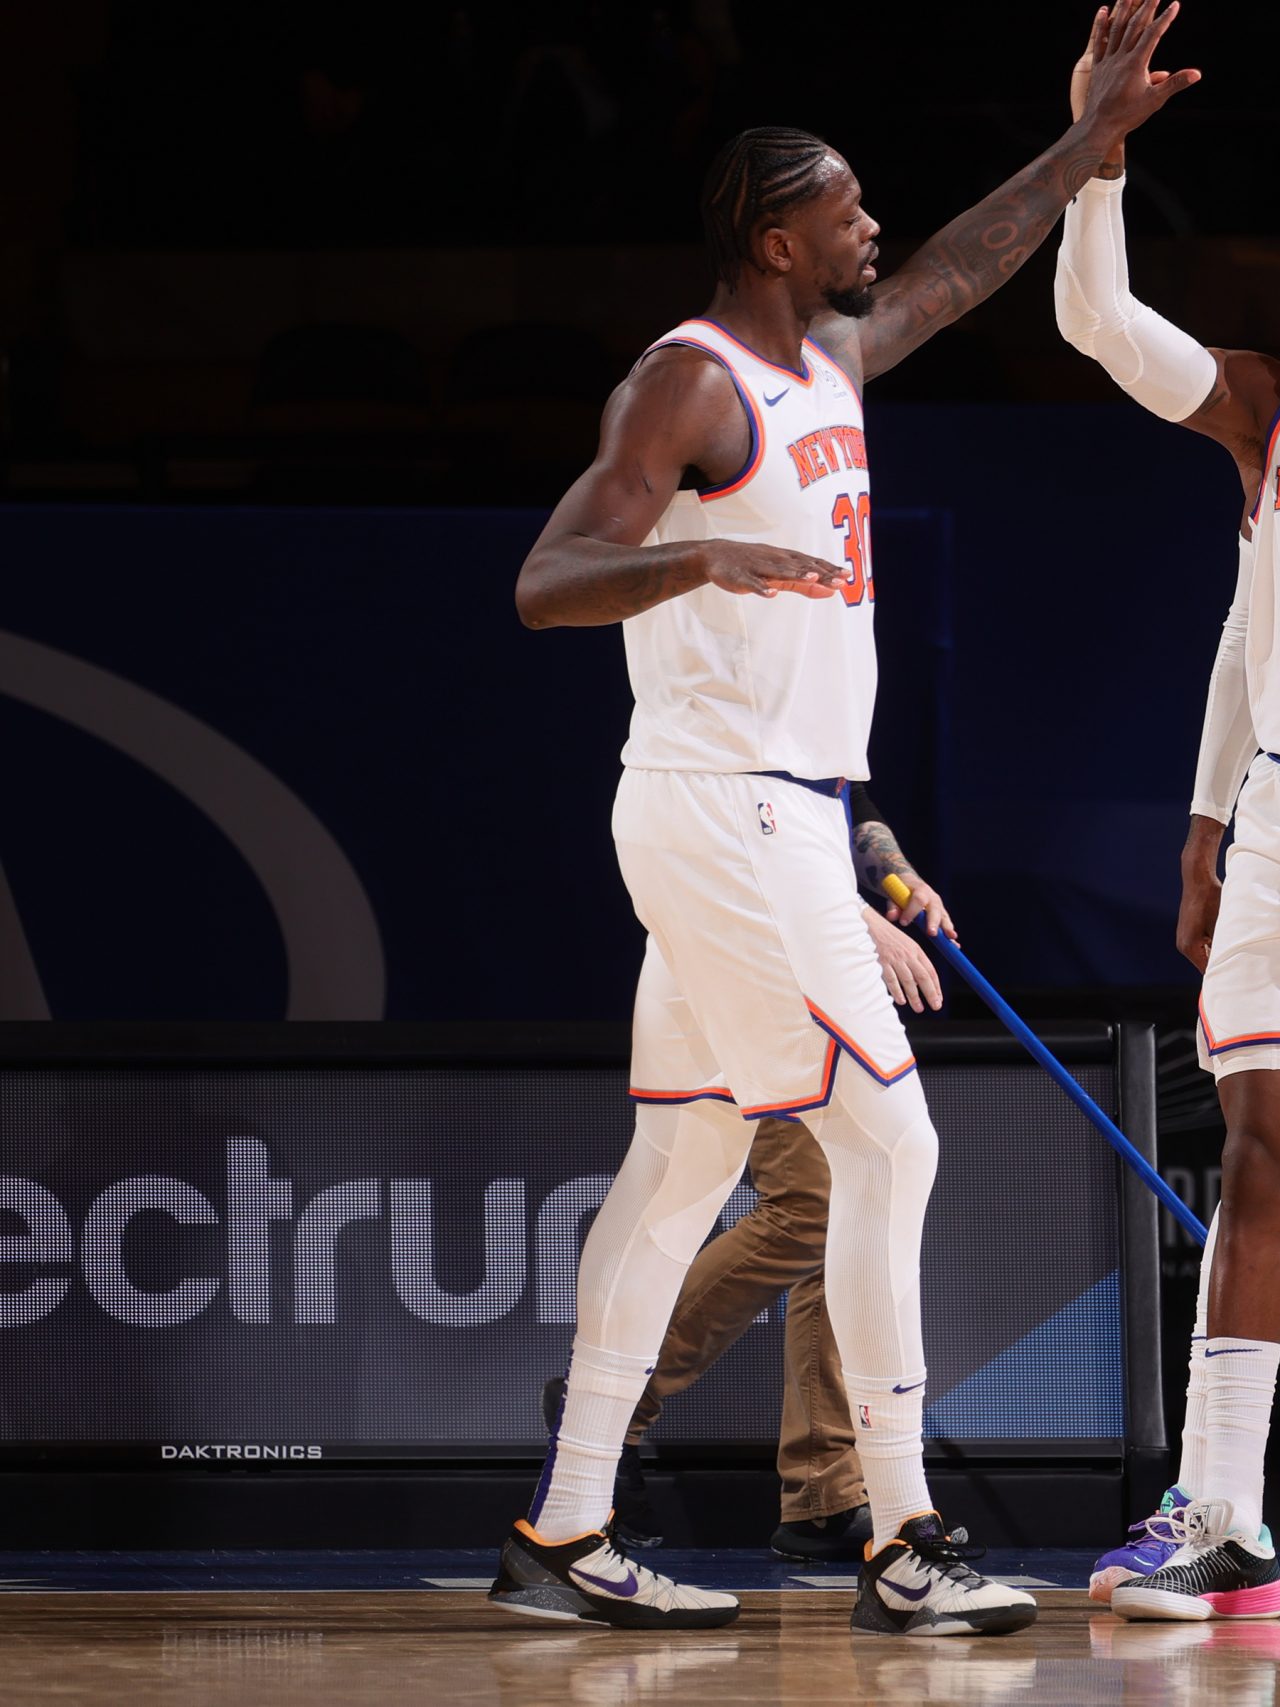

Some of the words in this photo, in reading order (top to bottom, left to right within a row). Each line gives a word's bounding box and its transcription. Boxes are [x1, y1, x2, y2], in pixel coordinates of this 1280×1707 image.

[787, 427, 840, 489] NEW
[832, 491, 875, 608] 30
[161, 1445, 322, 1459] DAKTRONICS
